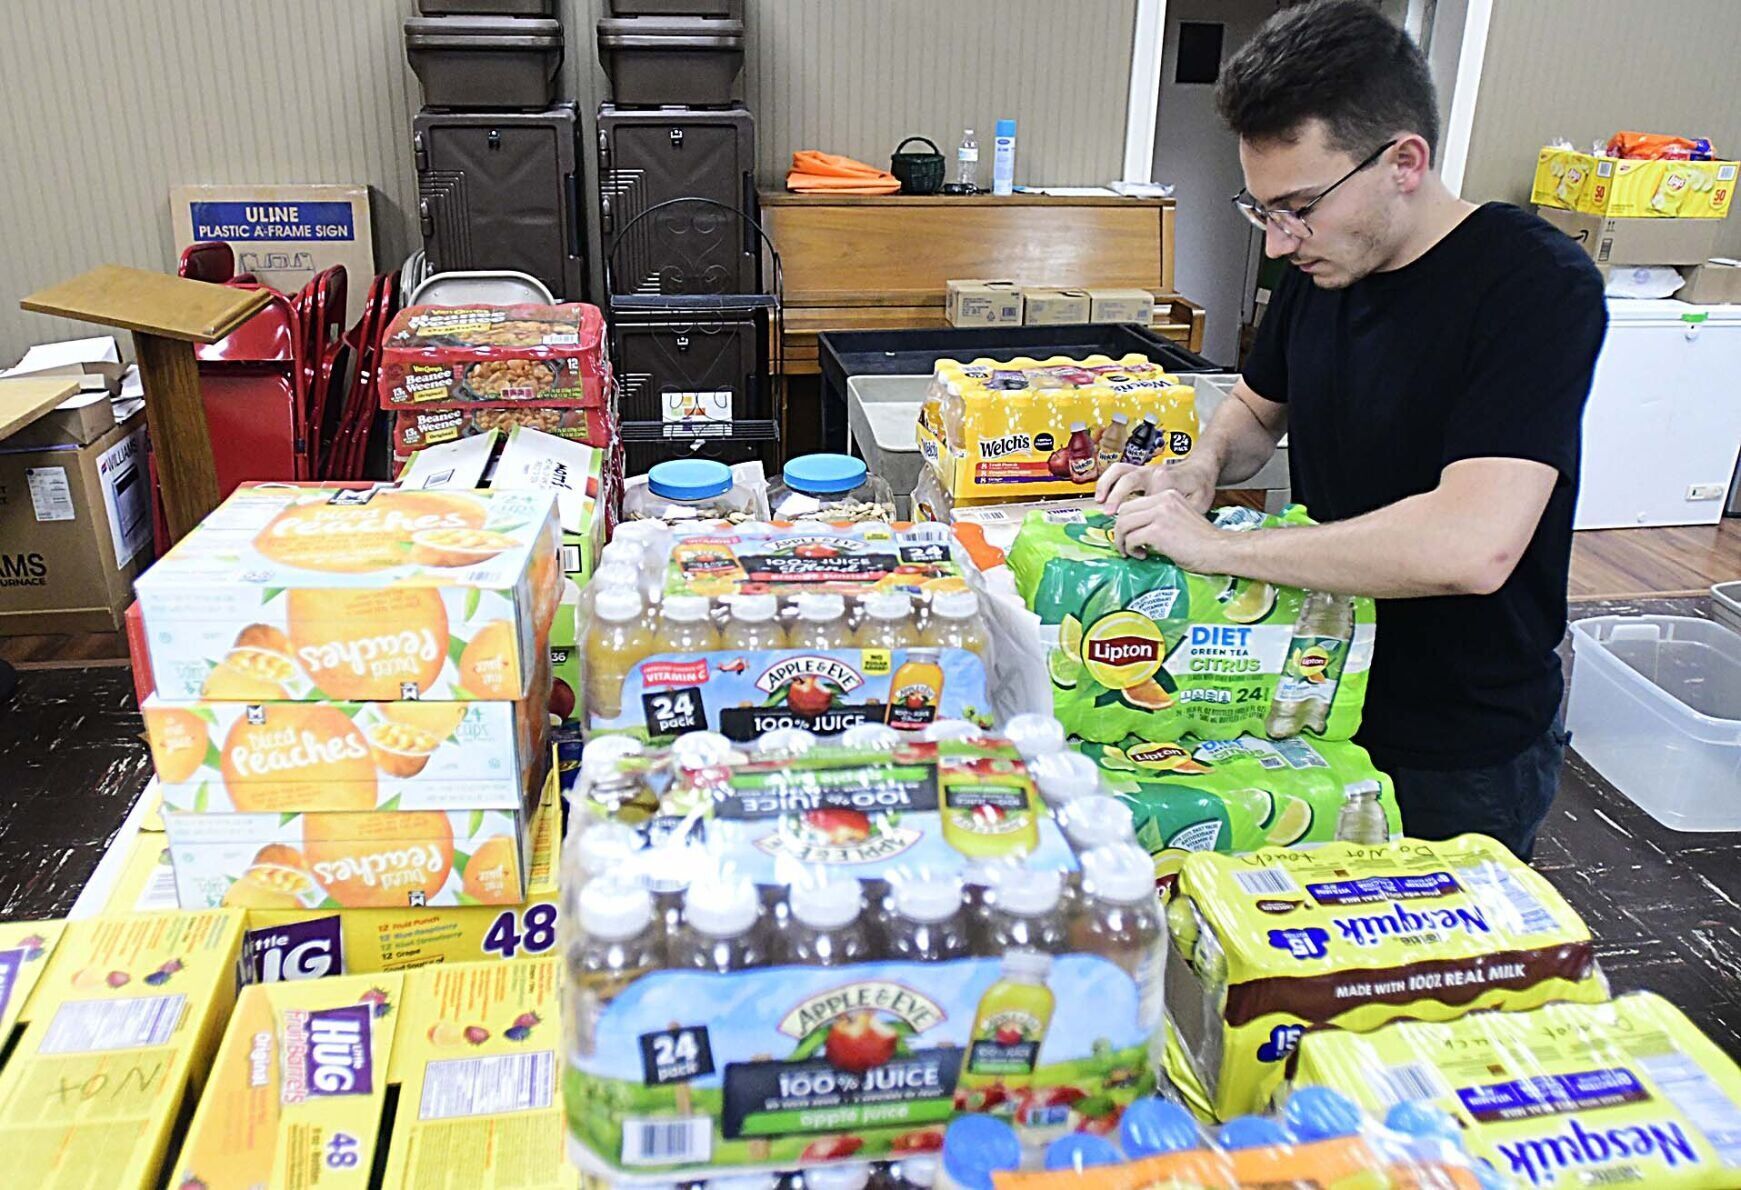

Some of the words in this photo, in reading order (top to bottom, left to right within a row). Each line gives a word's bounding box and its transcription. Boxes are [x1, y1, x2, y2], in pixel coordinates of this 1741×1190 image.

[1594, 186, 1605, 198] 50
[1713, 189, 1727, 202] 50
[245, 206, 299, 223] ULINE
[199, 224, 250, 238] PLASTIC
[253, 224, 312, 238] A-FRAME
[315, 224, 348, 238] SIGN
[567, 358, 579, 370] 12
[405, 370, 452, 385] Beanee
[405, 378, 453, 393] Weenee
[417, 410, 461, 426] Beanee
[417, 418, 463, 433] Weenee
[980, 435, 1030, 457] Welch's
[1173, 433, 1189, 446] 24
[107, 438, 137, 472] WILLIAMS
[271, 512, 468, 537] Peaches
[908, 547, 942, 556] 24
[765, 558, 812, 567] 100%
[819, 558, 871, 567] JUICE
[0, 578, 46, 586] URNACE
[1191, 627, 1252, 646] DIET
[300, 628, 438, 674] Peaches
[551, 652, 566, 662] 36
[1094, 642, 1152, 662] Lipton
[1190, 648, 1227, 657] GREEN
[1229, 648, 1249, 657] TEA
[646, 671, 696, 681] VITAMIN
[697, 670, 706, 680] C
[768, 660, 814, 691] APPLE
[816, 663, 827, 673] &
[828, 664, 857, 689] EVE
[1188, 658, 1261, 673] CITRUS
[1236, 686, 1263, 703] 24
[653, 695, 695, 721] 24
[659, 715, 695, 731] pack
[754, 717, 810, 732] 100%
[815, 715, 866, 732] JUICE
[248, 727, 296, 753] Diced
[231, 730, 368, 776] Peaches
[1134, 748, 1185, 762] Lipton
[742, 792, 821, 812] JUICE
[829, 792, 911, 808] 100%
[314, 845, 443, 885] Peaches
[481, 903, 558, 959] 48
[1333, 902, 1491, 946] Nesquik
[381, 952, 393, 961] 12
[395, 948, 422, 960] Grape
[1293, 936, 1319, 957] 15
[1335, 984, 1372, 999] MADE
[1373, 981, 1405, 995] WITH
[1408, 974, 1443, 992] 100%
[1444, 968, 1486, 987] REAL
[1487, 963, 1526, 982] MILK
[797, 988, 871, 1037] APPLE
[873, 988, 889, 1007] &
[891, 991, 935, 1029] EVE
[653, 1031, 699, 1062] 24
[1277, 1029, 1302, 1051] 15
[250, 1032, 272, 1087] Original
[310, 1018, 361, 1092] HUG
[658, 1060, 699, 1082] pack
[779, 1070, 860, 1098] 100%
[863, 1067, 939, 1092] JUICE
[800, 1107, 858, 1129] apple
[861, 1104, 909, 1123] juice
[326, 1133, 358, 1168] 48
[1497, 1118, 1699, 1186] Nesquik
